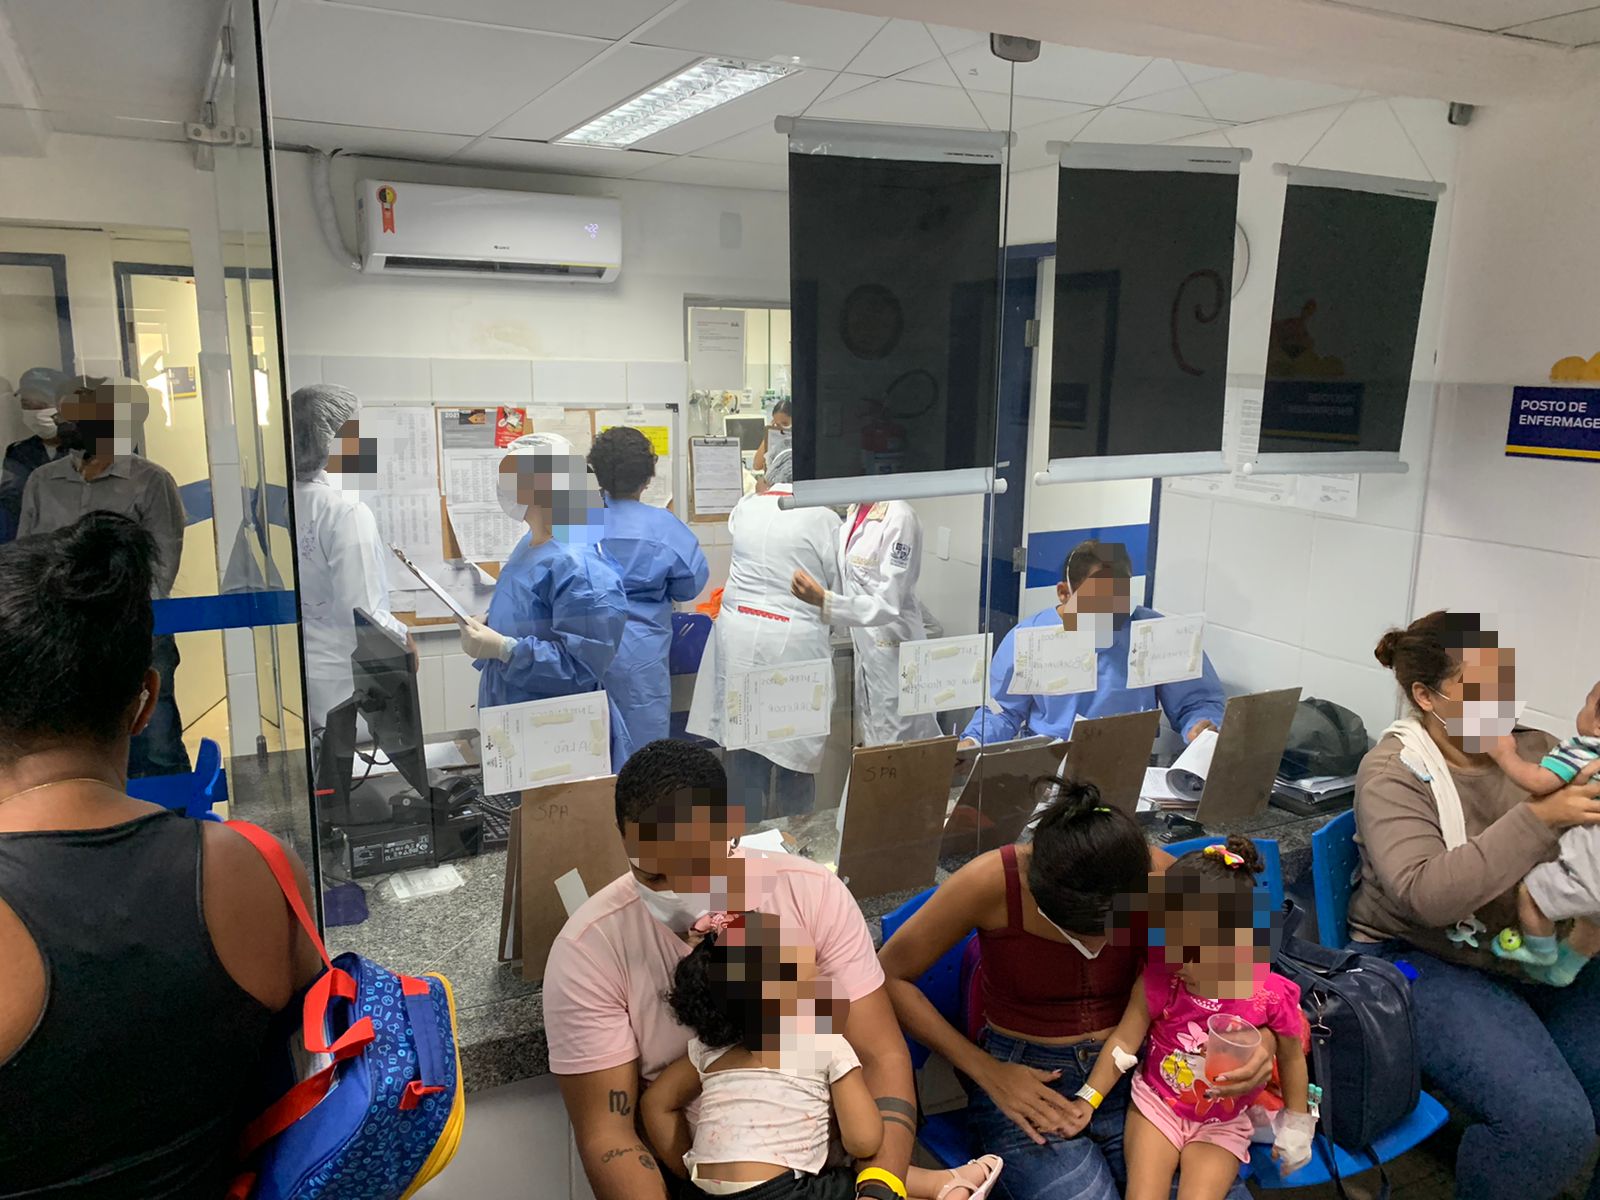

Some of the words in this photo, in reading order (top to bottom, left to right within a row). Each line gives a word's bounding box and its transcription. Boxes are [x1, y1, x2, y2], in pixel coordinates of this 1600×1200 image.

[1520, 399, 1566, 412] POSTO
[1568, 401, 1588, 413] DE
[863, 766, 897, 783] SPA
[535, 804, 569, 822] SPA
